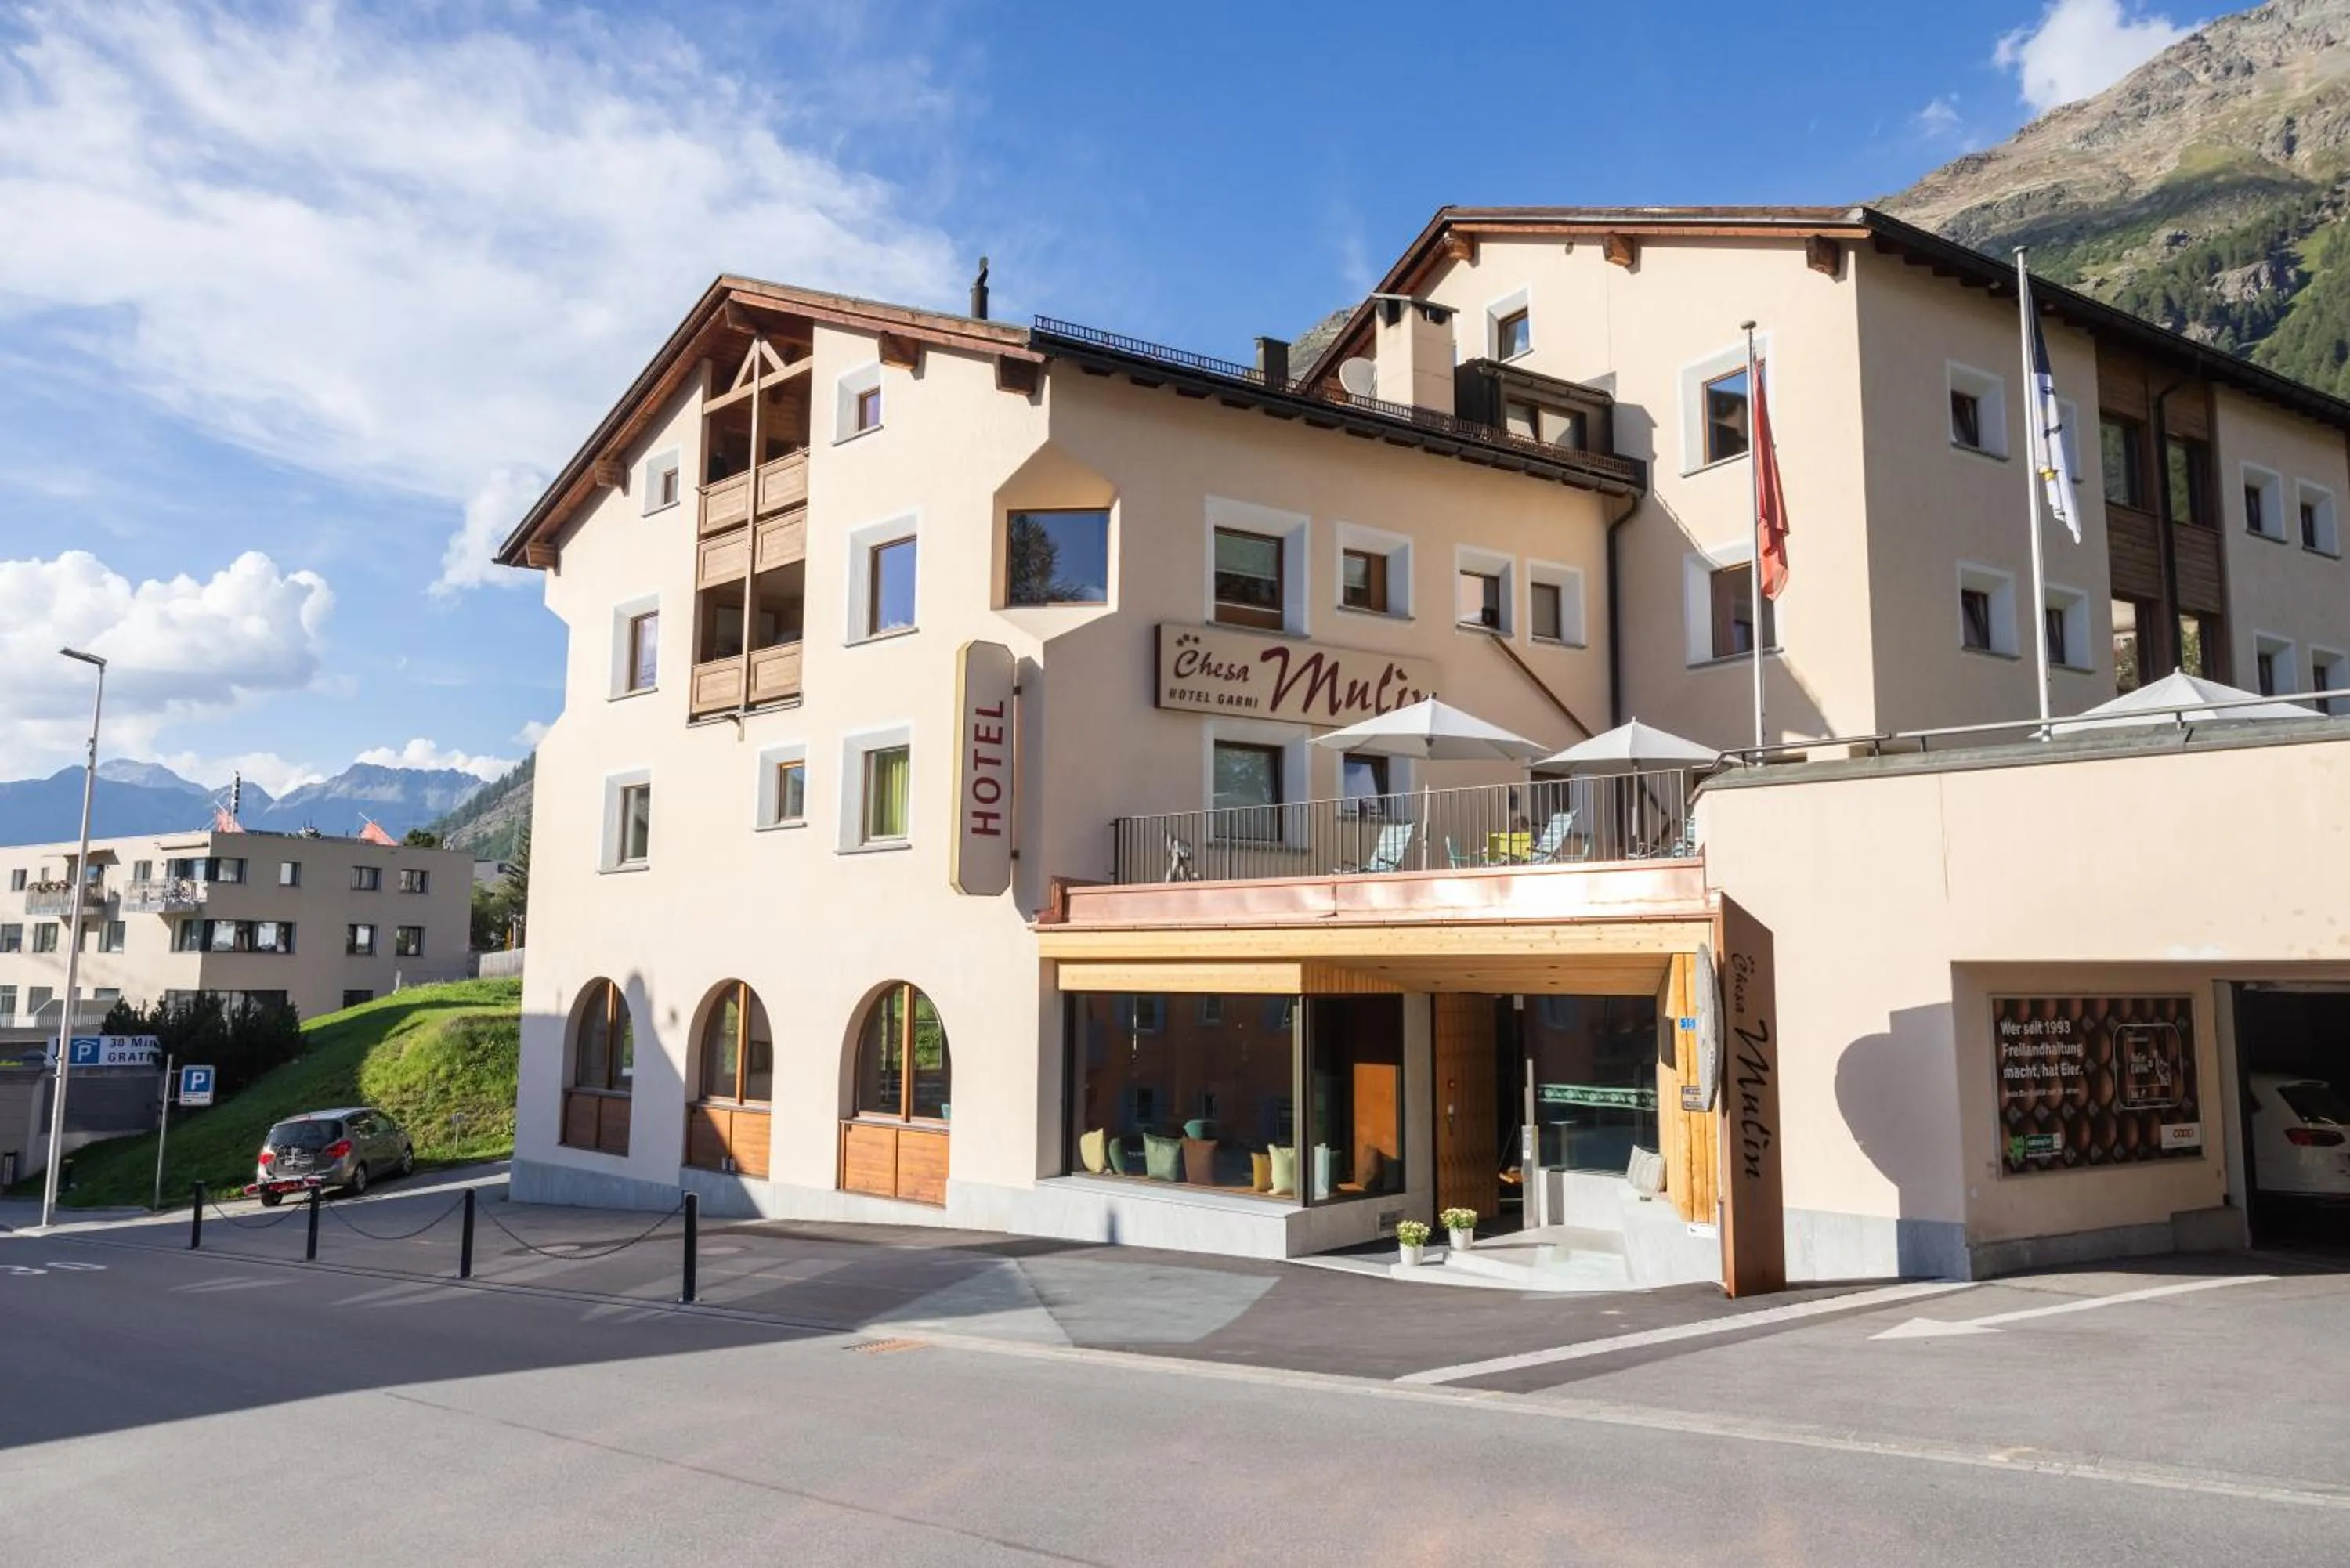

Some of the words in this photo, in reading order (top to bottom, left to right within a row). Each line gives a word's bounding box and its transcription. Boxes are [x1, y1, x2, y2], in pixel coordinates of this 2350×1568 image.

[1174, 649, 1249, 683] Chesa
[1169, 688, 1210, 703] HOTEL
[1218, 693, 1259, 709] GARNI
[971, 701, 1003, 836] HOTEL
[1731, 952, 1749, 1013] Chesa
[2000, 1021, 2022, 1035] Wer
[2023, 1021, 2043, 1035] seit
[2044, 1021, 2070, 1035] 1993
[109, 1038, 125, 1048] 30
[2001, 1041, 2084, 1057] Freilandhaltung
[107, 1052, 155, 1063] GRATI
[2003, 1064, 2041, 1079] macht,
[2042, 1062, 2059, 1077] hat
[2061, 1061, 2084, 1076] Eier.
[191, 1071, 205, 1090] P
[1734, 1020, 1772, 1179] Mulin
